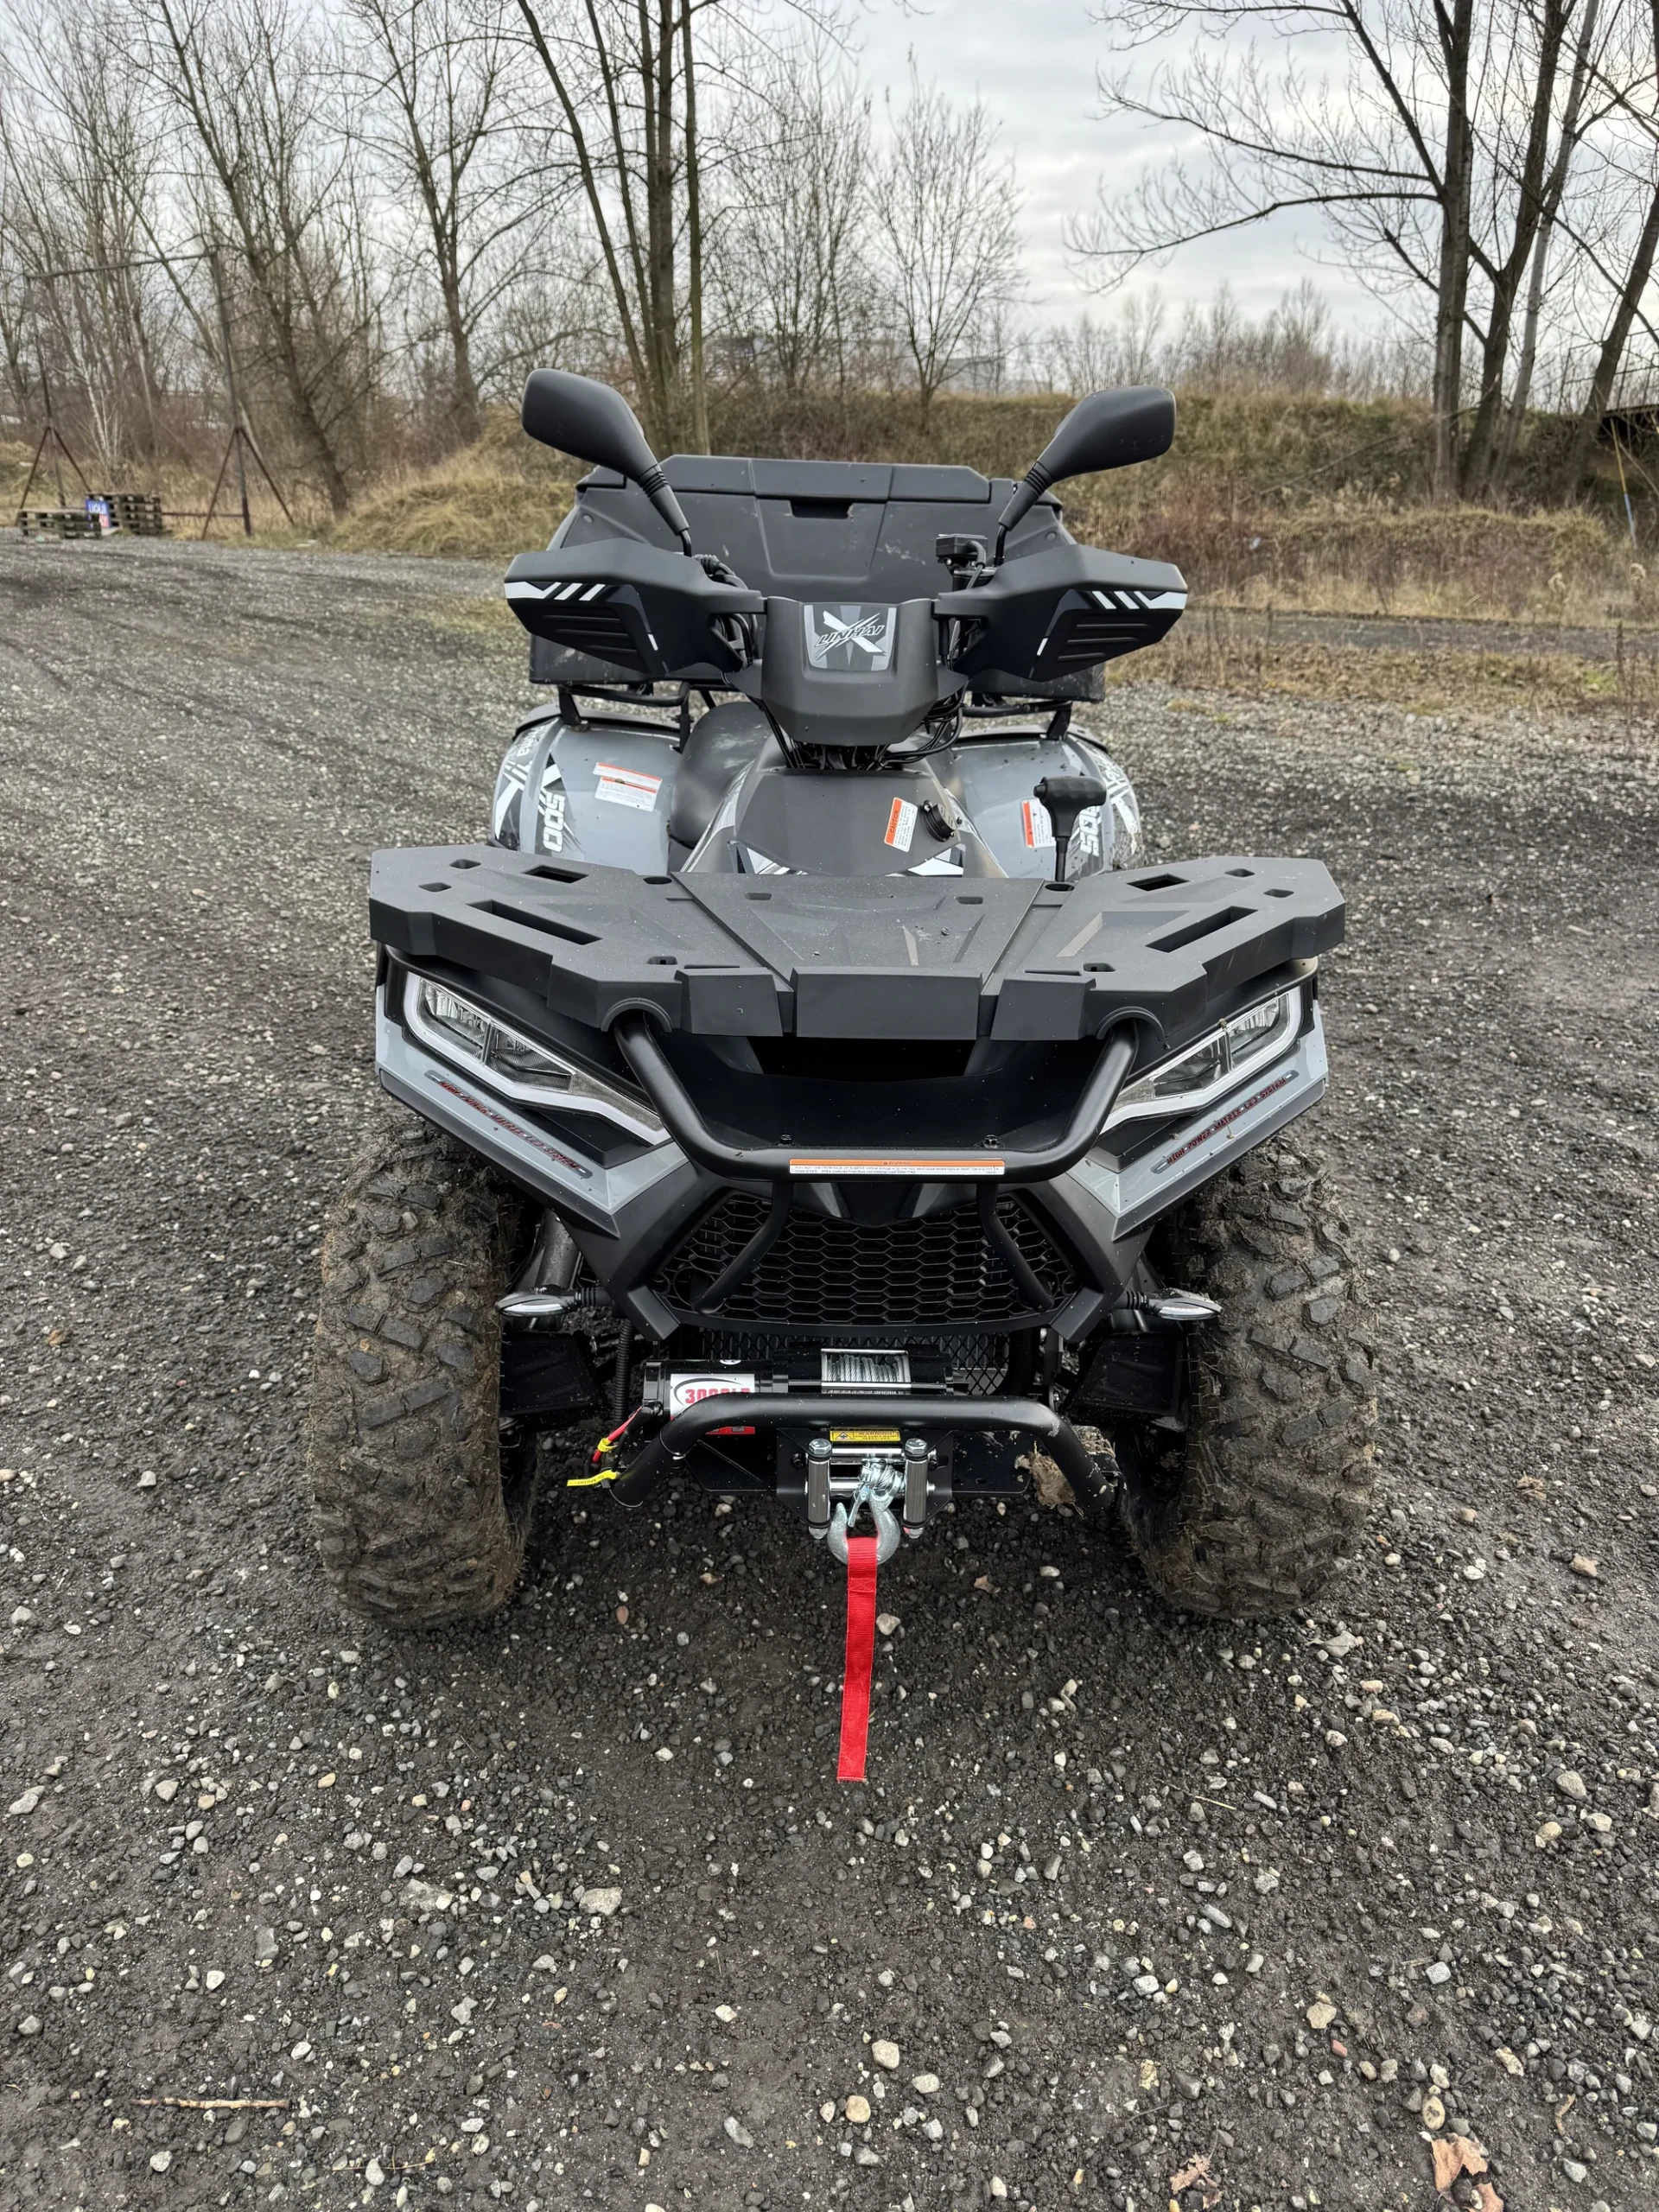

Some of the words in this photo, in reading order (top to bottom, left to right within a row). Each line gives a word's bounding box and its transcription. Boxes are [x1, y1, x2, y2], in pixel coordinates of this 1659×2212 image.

[815, 625, 885, 648] LINHAI
[543, 791, 566, 853] 500
[890, 810, 899, 834] CAUTION
[438, 1080, 461, 1096] HIGH
[461, 1096, 492, 1116] POWER
[491, 1114, 524, 1136] MATRIX
[525, 1135, 544, 1149] LED
[544, 1147, 580, 1170] SYSTEM
[1167, 1147, 1185, 1165] HIGH
[1186, 1128, 1212, 1150] POWER
[1213, 1107, 1242, 1132] MATRIX
[1243, 1096, 1258, 1109] LED
[1259, 1077, 1287, 1099] SYSTEM
